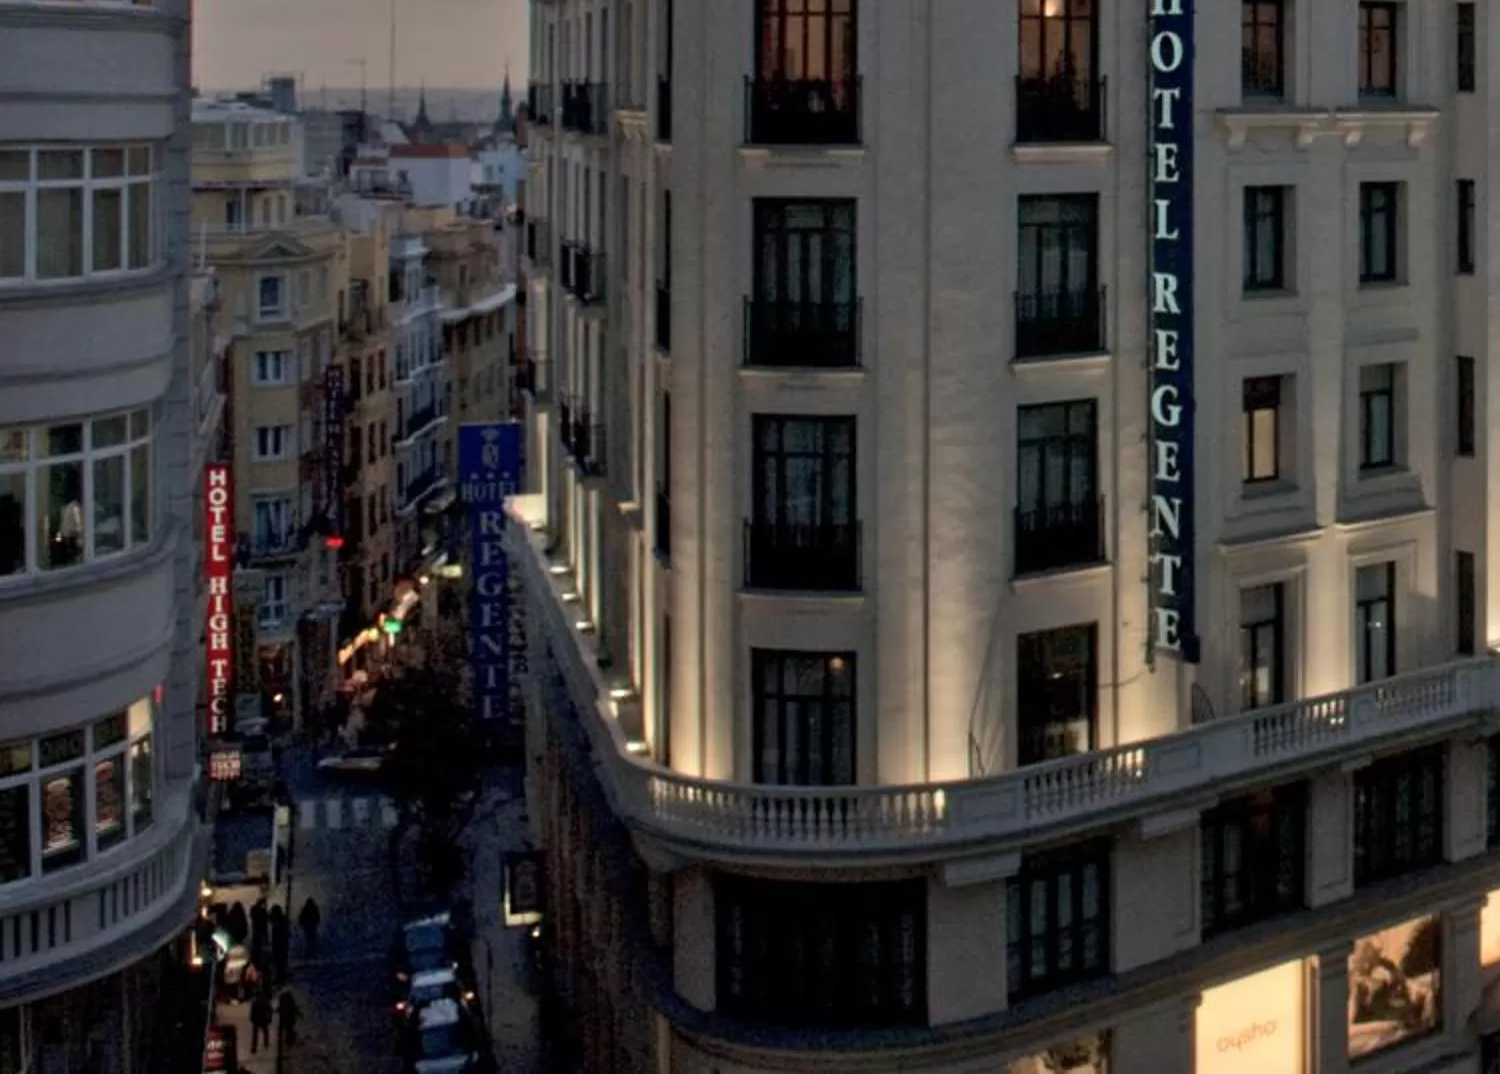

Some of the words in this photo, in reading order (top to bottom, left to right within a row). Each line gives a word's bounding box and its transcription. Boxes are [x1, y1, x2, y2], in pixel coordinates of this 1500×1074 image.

[1151, 272, 1184, 653] REGENTE
[208, 469, 226, 562] HOTEL
[208, 577, 227, 650] HIGH
[476, 510, 505, 719] REGENTE
[209, 659, 228, 734] TECH
[1216, 1019, 1277, 1053] oysho
